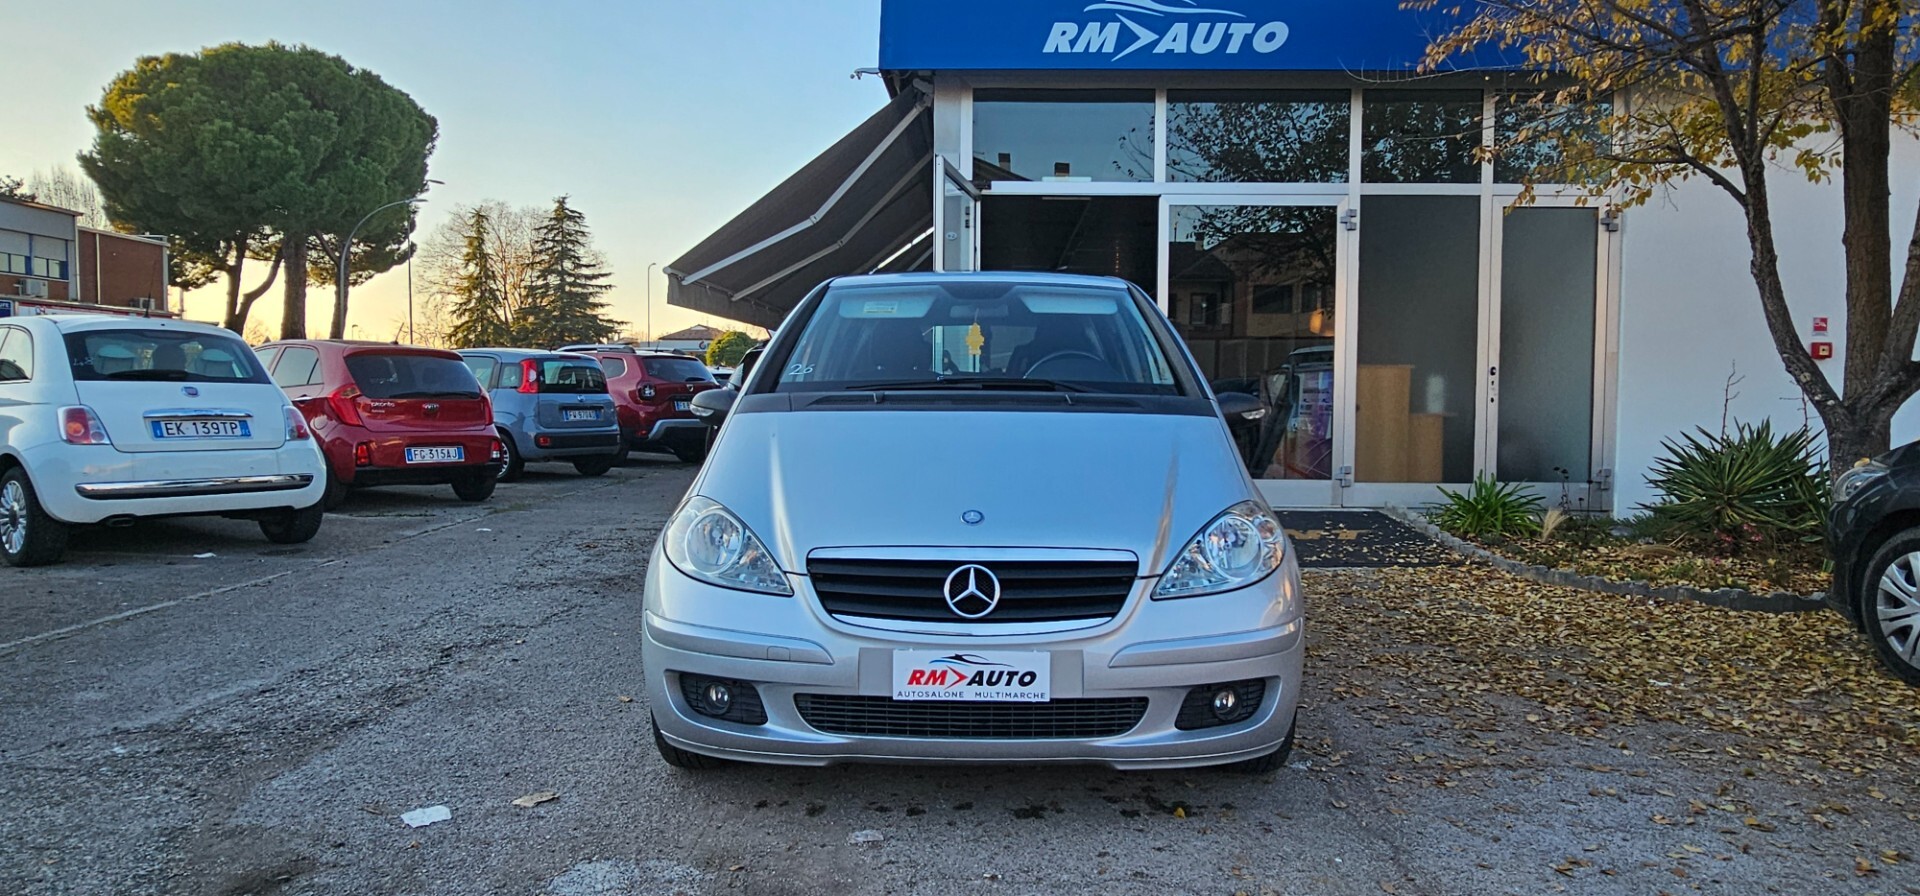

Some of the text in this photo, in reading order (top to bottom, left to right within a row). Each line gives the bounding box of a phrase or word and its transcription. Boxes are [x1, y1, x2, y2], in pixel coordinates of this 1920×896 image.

[1042, 21, 1290, 55] RM AUTO
[788, 363, 816, 376] 26
[164, 422, 185, 435] EK
[192, 421, 238, 435] 139TP
[429, 449, 457, 459] 315AJ
[907, 669, 1037, 687] RM AUTO
[897, 690, 1046, 700] AUTOSALONE MULTIMARCHE
